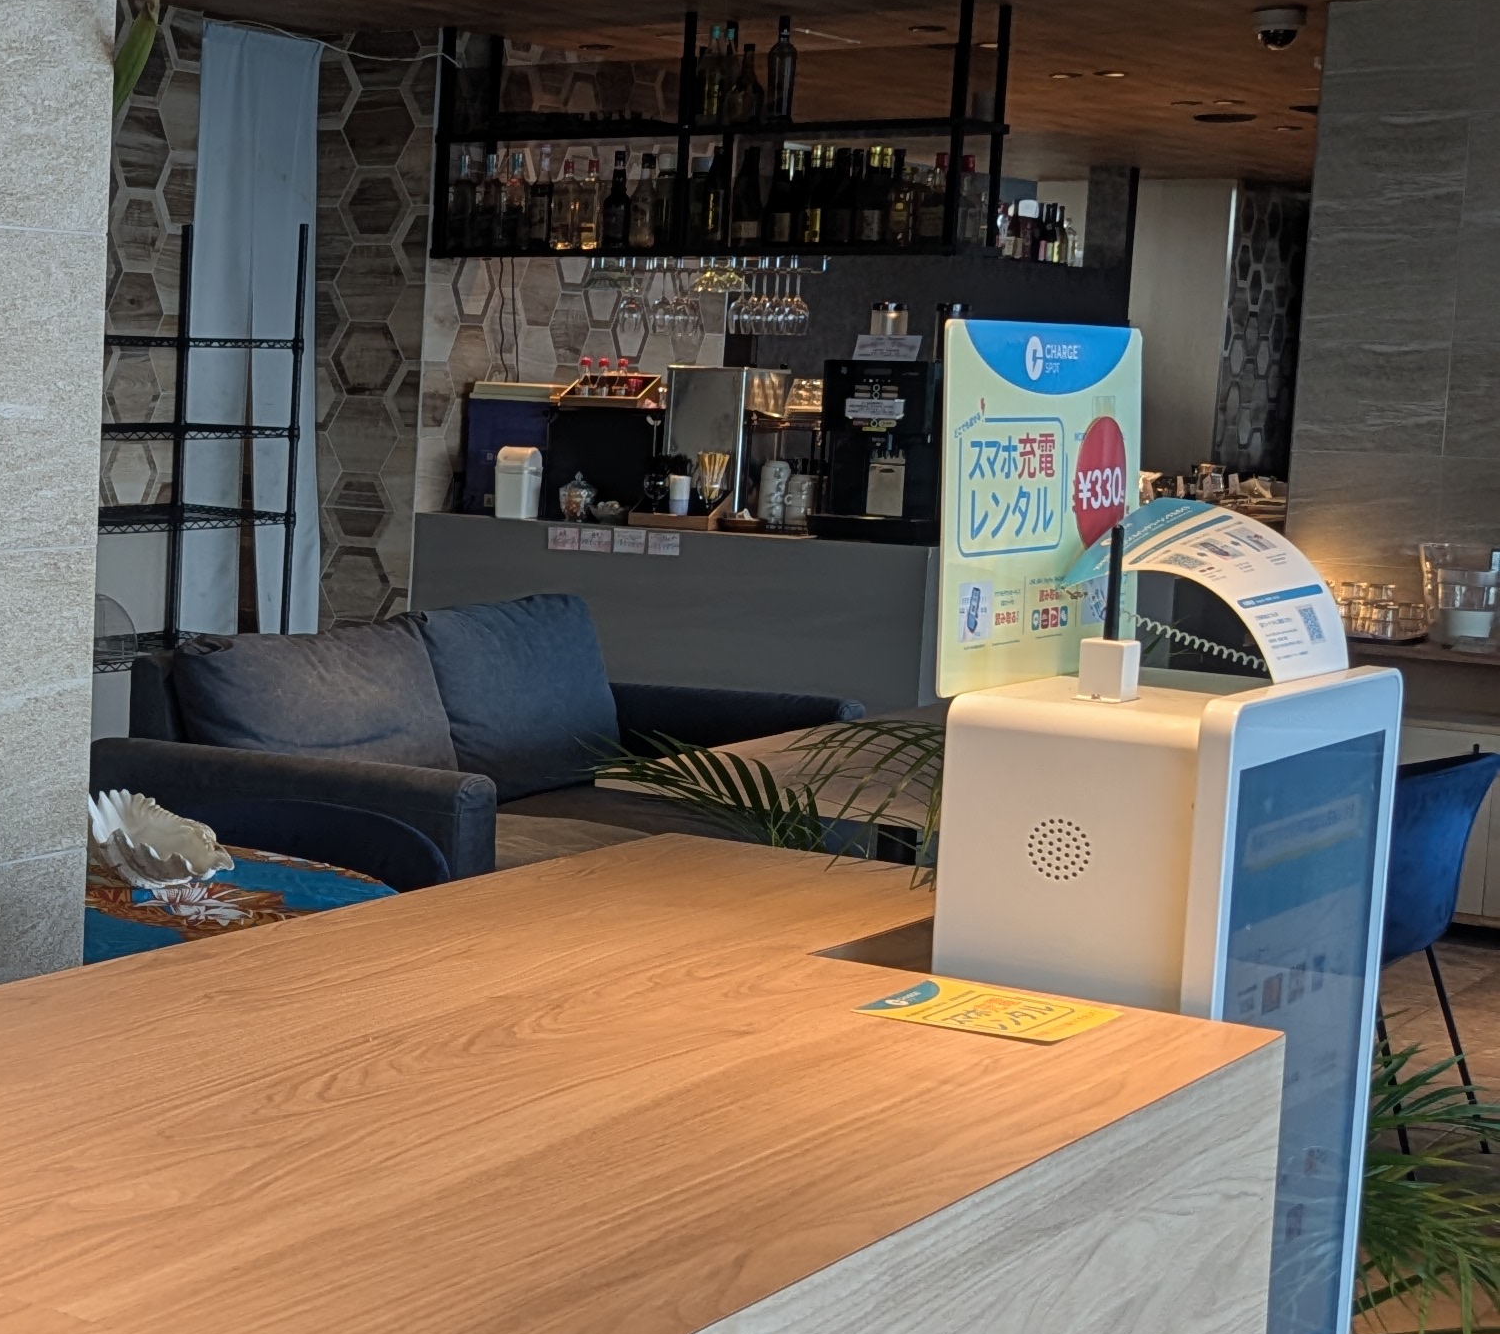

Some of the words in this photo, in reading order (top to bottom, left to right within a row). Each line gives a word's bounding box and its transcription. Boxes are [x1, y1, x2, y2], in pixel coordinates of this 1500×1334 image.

[1045, 344, 1079, 359] CHARGE
[969, 432, 1055, 479] スマホ充電
[970, 485, 1054, 540] レンタル
